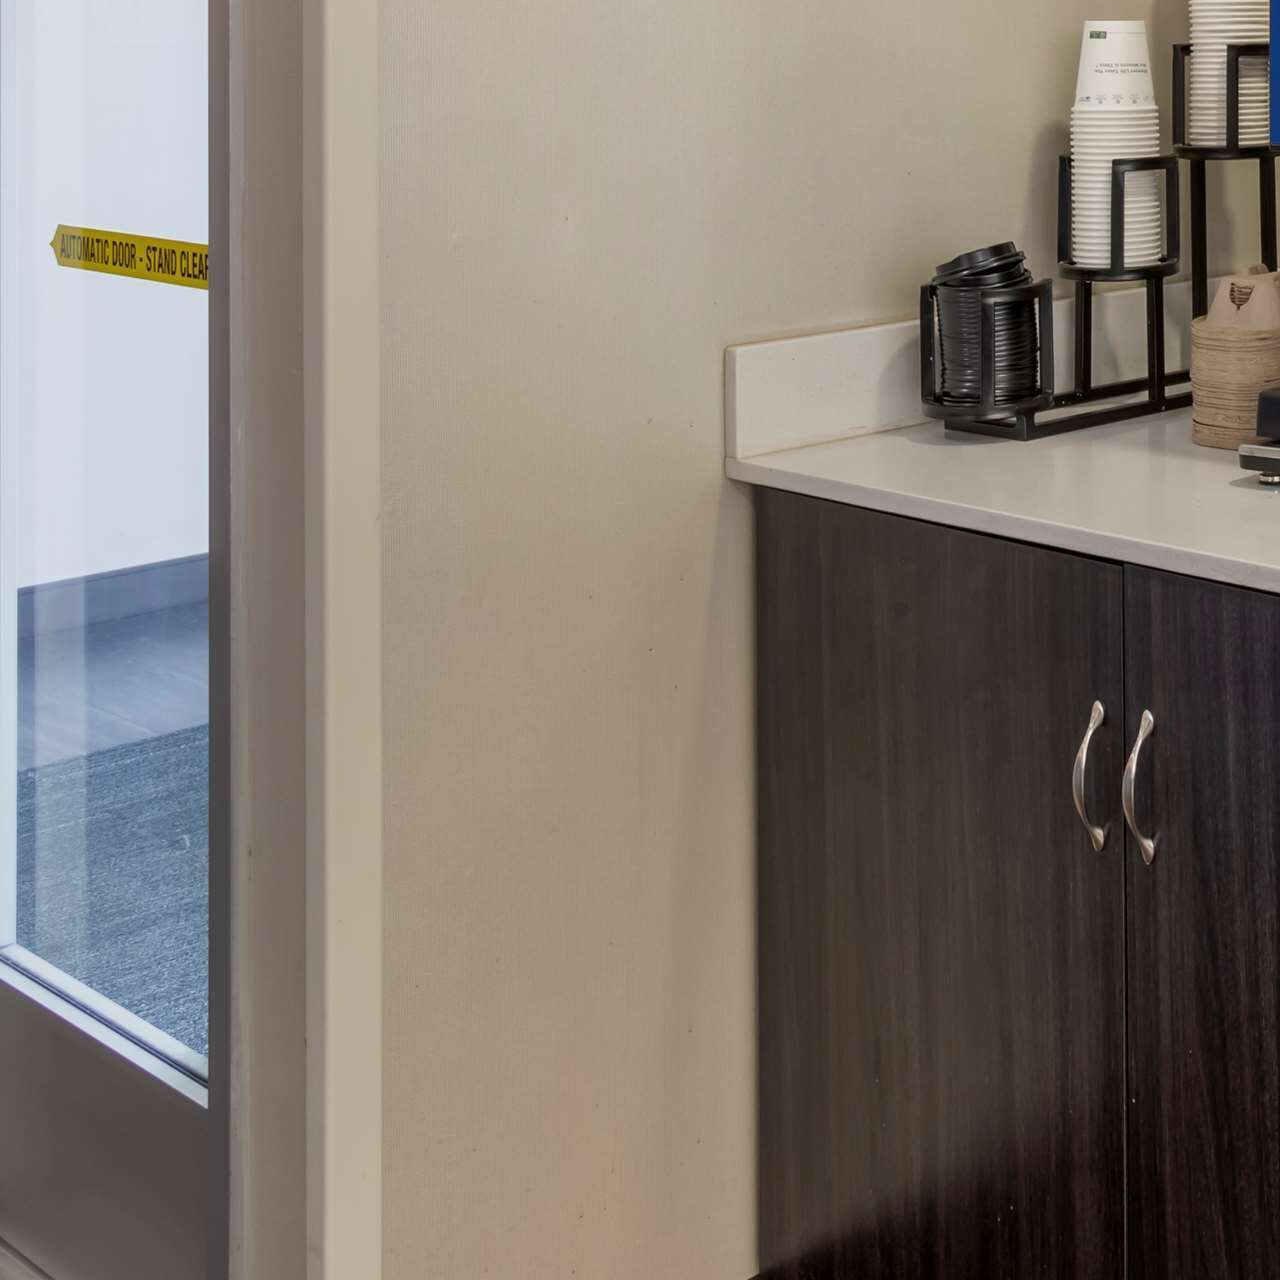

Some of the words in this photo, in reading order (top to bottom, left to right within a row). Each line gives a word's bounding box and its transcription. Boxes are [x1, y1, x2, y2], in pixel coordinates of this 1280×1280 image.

[61, 234, 109, 266] AUTOMATIC
[112, 240, 137, 269] DOOR
[146, 246, 177, 275] STAND
